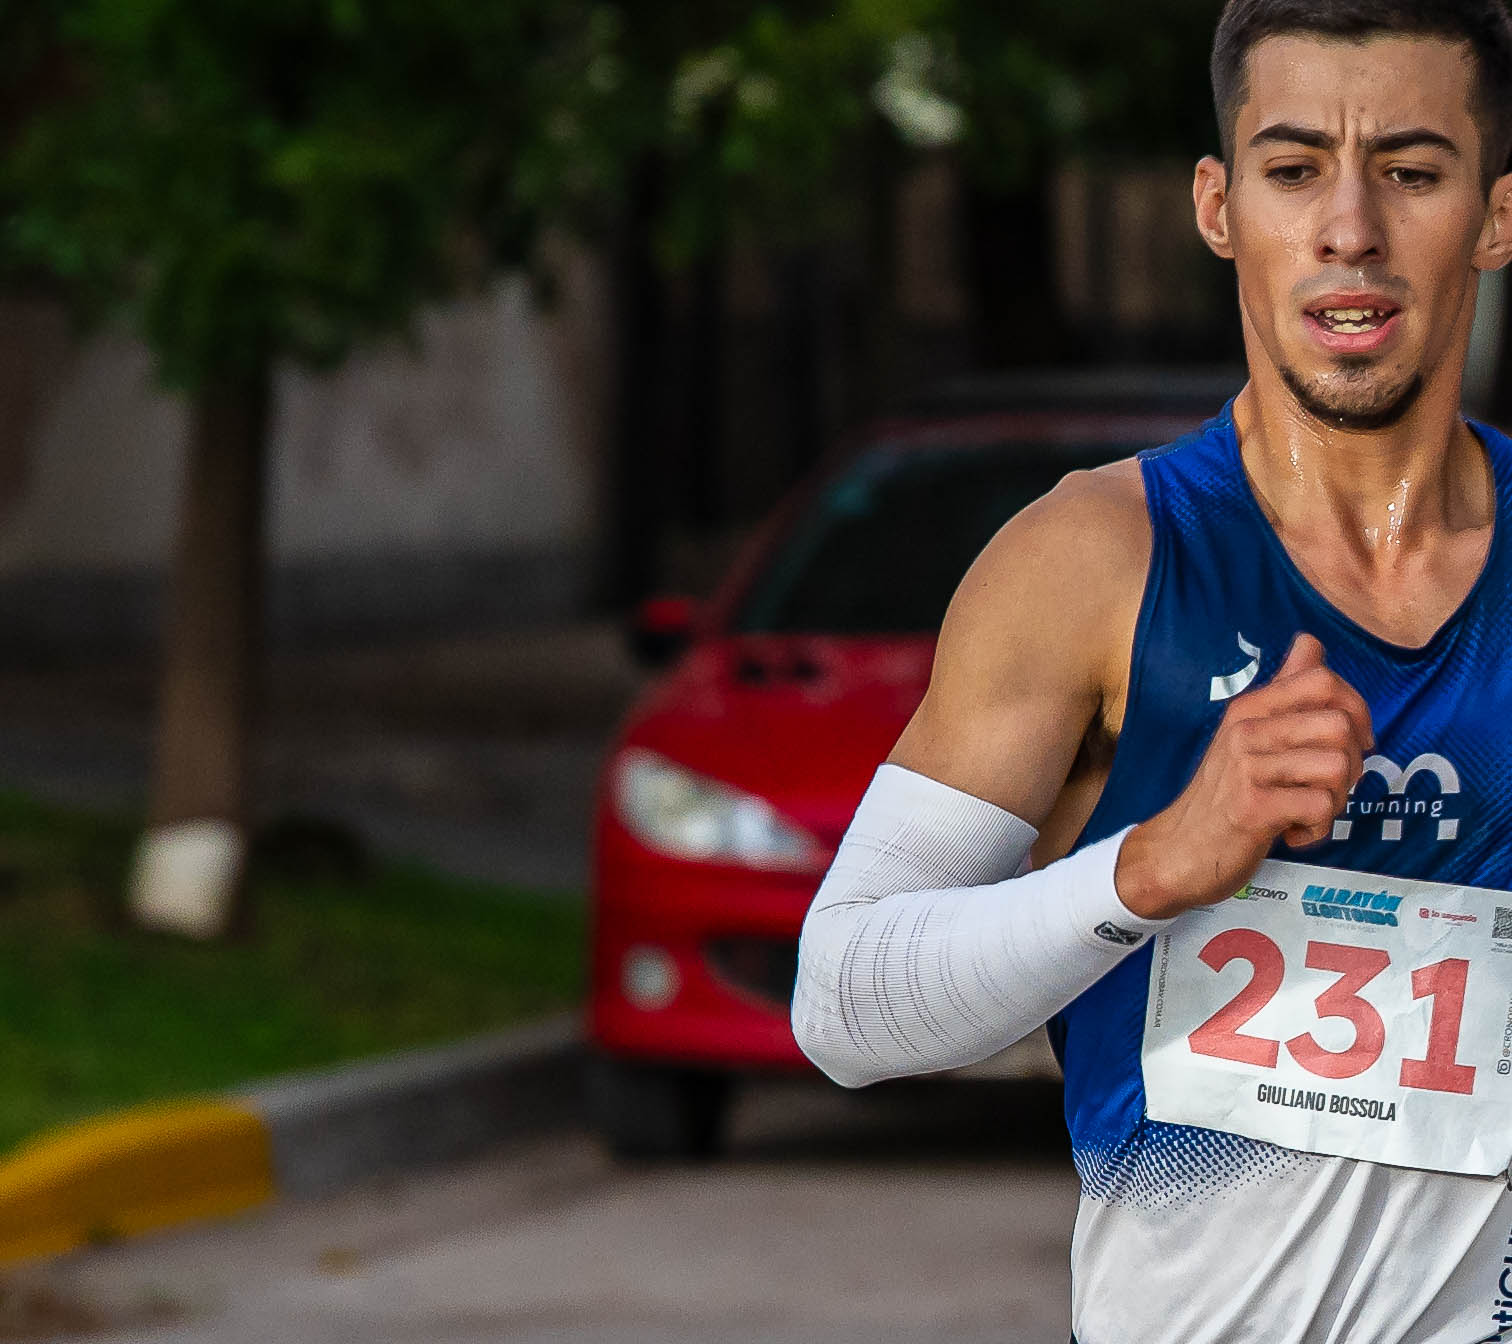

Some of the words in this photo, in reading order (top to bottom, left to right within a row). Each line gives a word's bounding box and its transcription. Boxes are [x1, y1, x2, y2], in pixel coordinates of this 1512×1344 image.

[1346, 798, 1443, 817] running
[1188, 928, 1476, 1095] 231
[1257, 1083, 1326, 1112] GIULIANO
[1329, 1094, 1396, 1122] BOSSOLA
